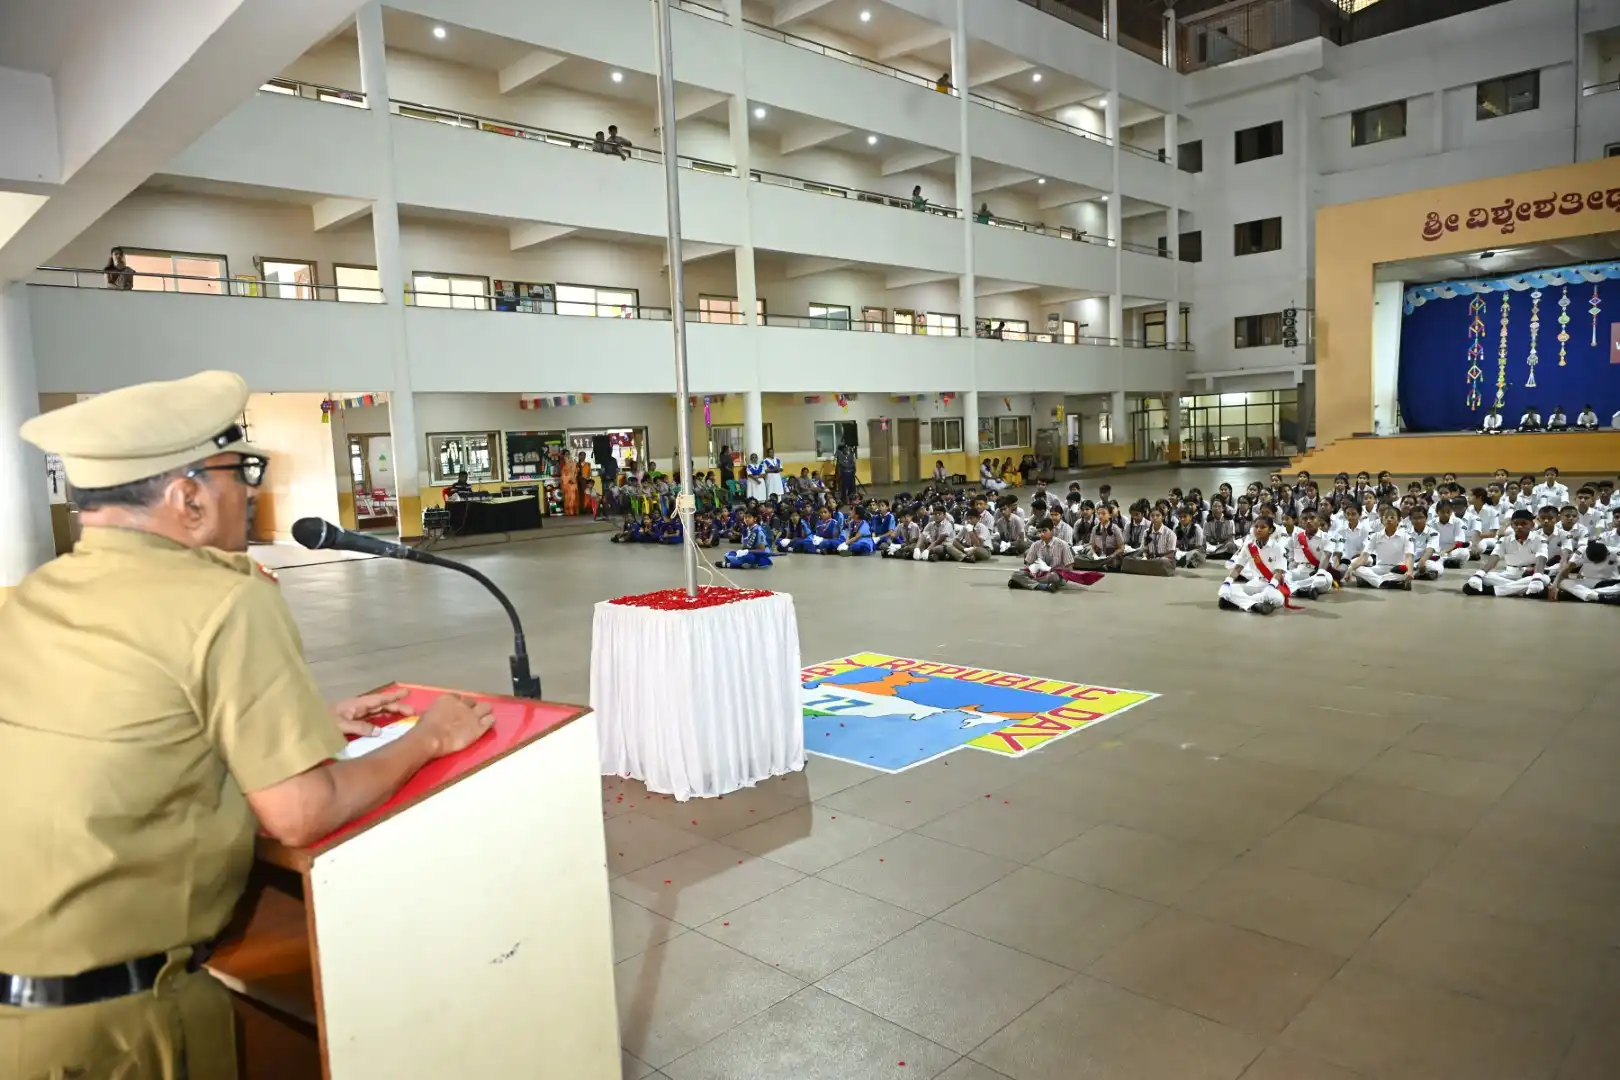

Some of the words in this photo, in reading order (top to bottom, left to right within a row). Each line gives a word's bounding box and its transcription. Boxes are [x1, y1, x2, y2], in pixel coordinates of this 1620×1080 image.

[1421, 211, 1460, 242] ಶ್ರೀ
[876, 657, 1119, 701] REPUBLIC
[802, 693, 874, 712] 77
[991, 706, 1106, 752] DAY
